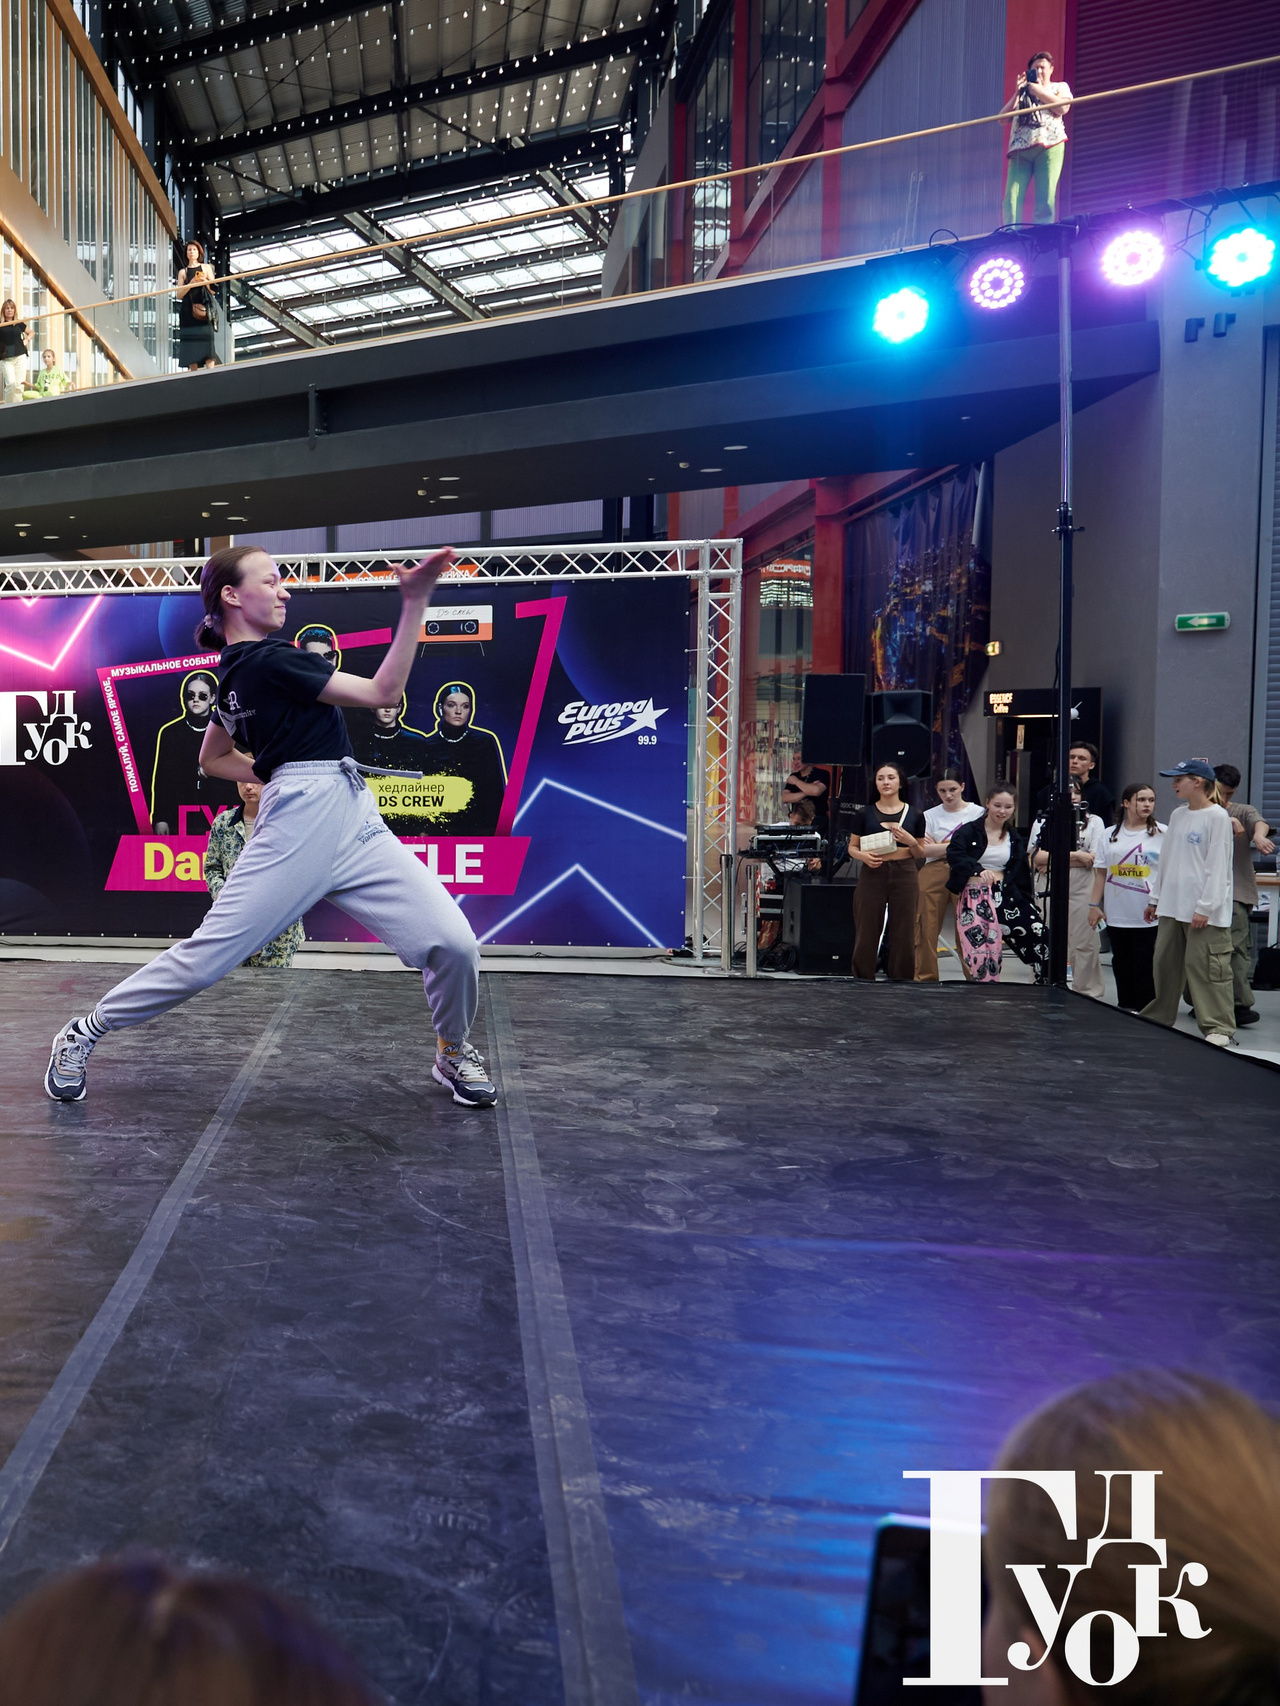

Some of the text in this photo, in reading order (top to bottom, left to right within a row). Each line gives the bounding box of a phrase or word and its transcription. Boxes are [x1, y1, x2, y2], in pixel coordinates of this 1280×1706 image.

[102, 654, 221, 793] ПОЖАЛУЙ, САМОЕ ЯРКОЕ, МУЗЫКАЛЬНОЕ СОБЫТИ
[637, 735, 657, 745] 99.9
[378, 782, 445, 794] хедлайнер
[379, 796, 445, 807] DS CREW
